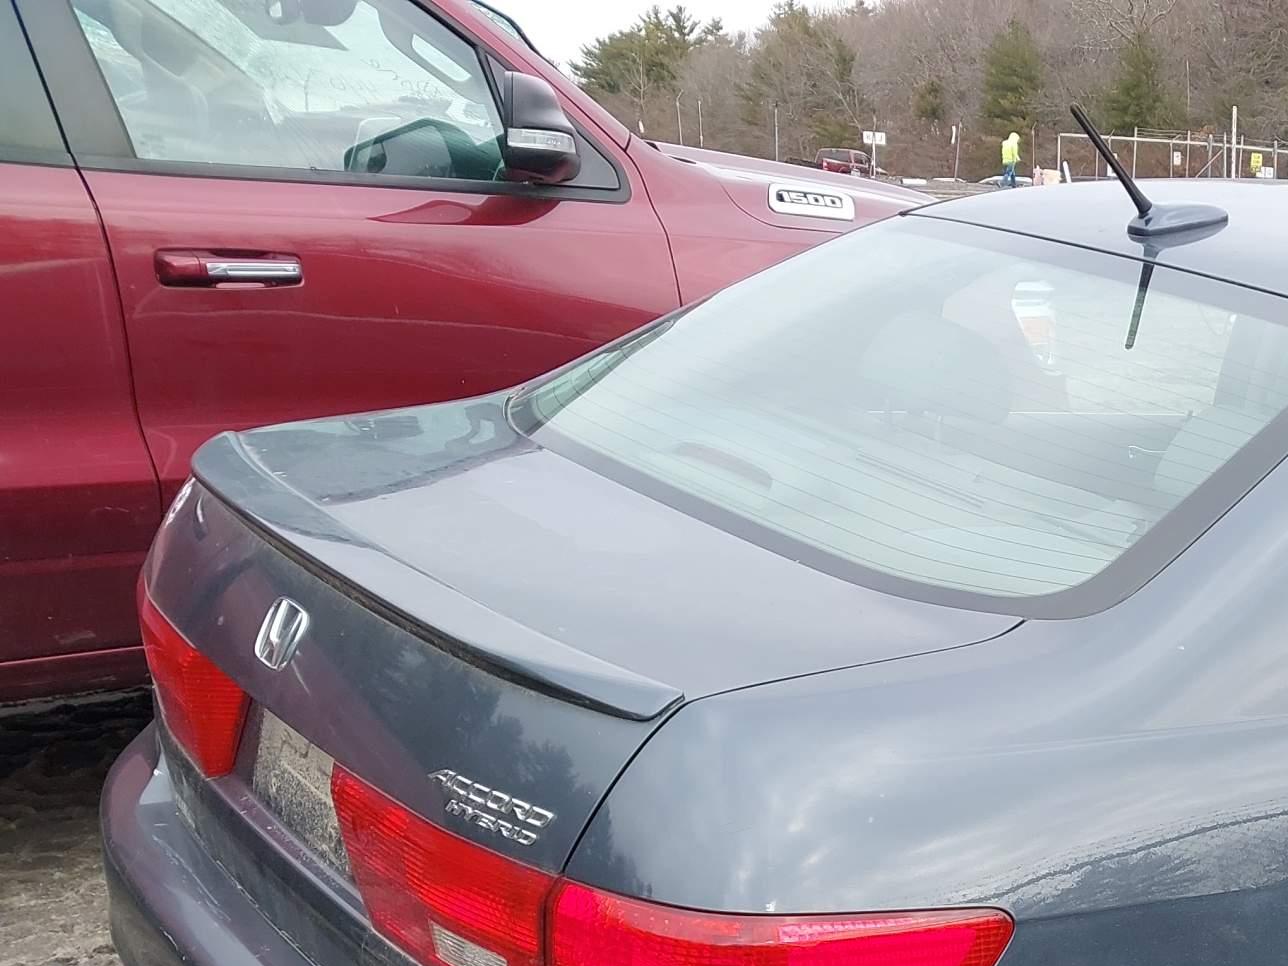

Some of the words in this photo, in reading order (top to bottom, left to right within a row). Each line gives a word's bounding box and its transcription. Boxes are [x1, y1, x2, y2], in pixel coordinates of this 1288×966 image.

[776, 189, 844, 209] 1500
[427, 768, 556, 828] ACCORD
[444, 799, 538, 846] HYBRID
